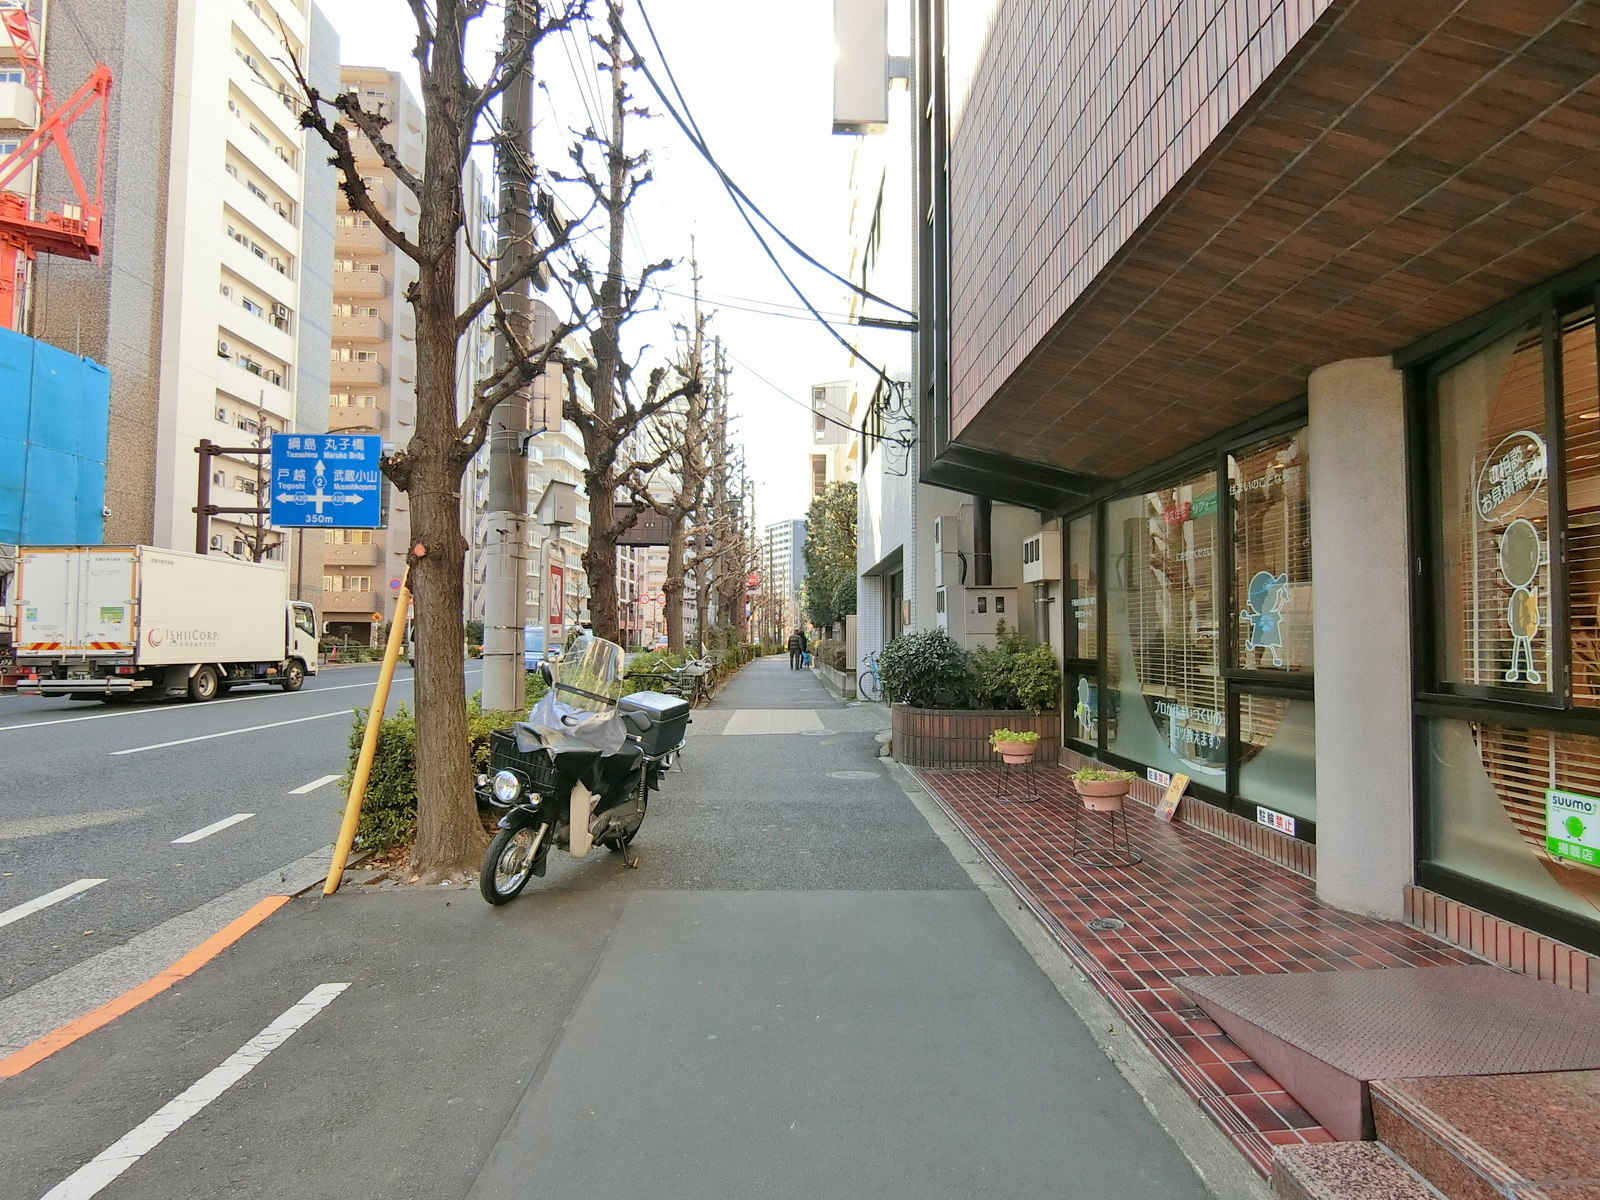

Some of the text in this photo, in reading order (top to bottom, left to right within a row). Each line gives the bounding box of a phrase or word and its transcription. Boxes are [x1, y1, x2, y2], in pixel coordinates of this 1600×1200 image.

[287, 437, 365, 451] 綱島 丸子橋
[277, 468, 306, 482] 戸越
[333, 469, 378, 483] 武蔵小山
[278, 482, 305, 490] Togoshi
[334, 483, 376, 491] Musashikoyama
[1229, 474, 1290, 496] 住まいのことなら
[305, 514, 333, 523] 350m
[1259, 809, 1293, 833] 駐輪禁止
